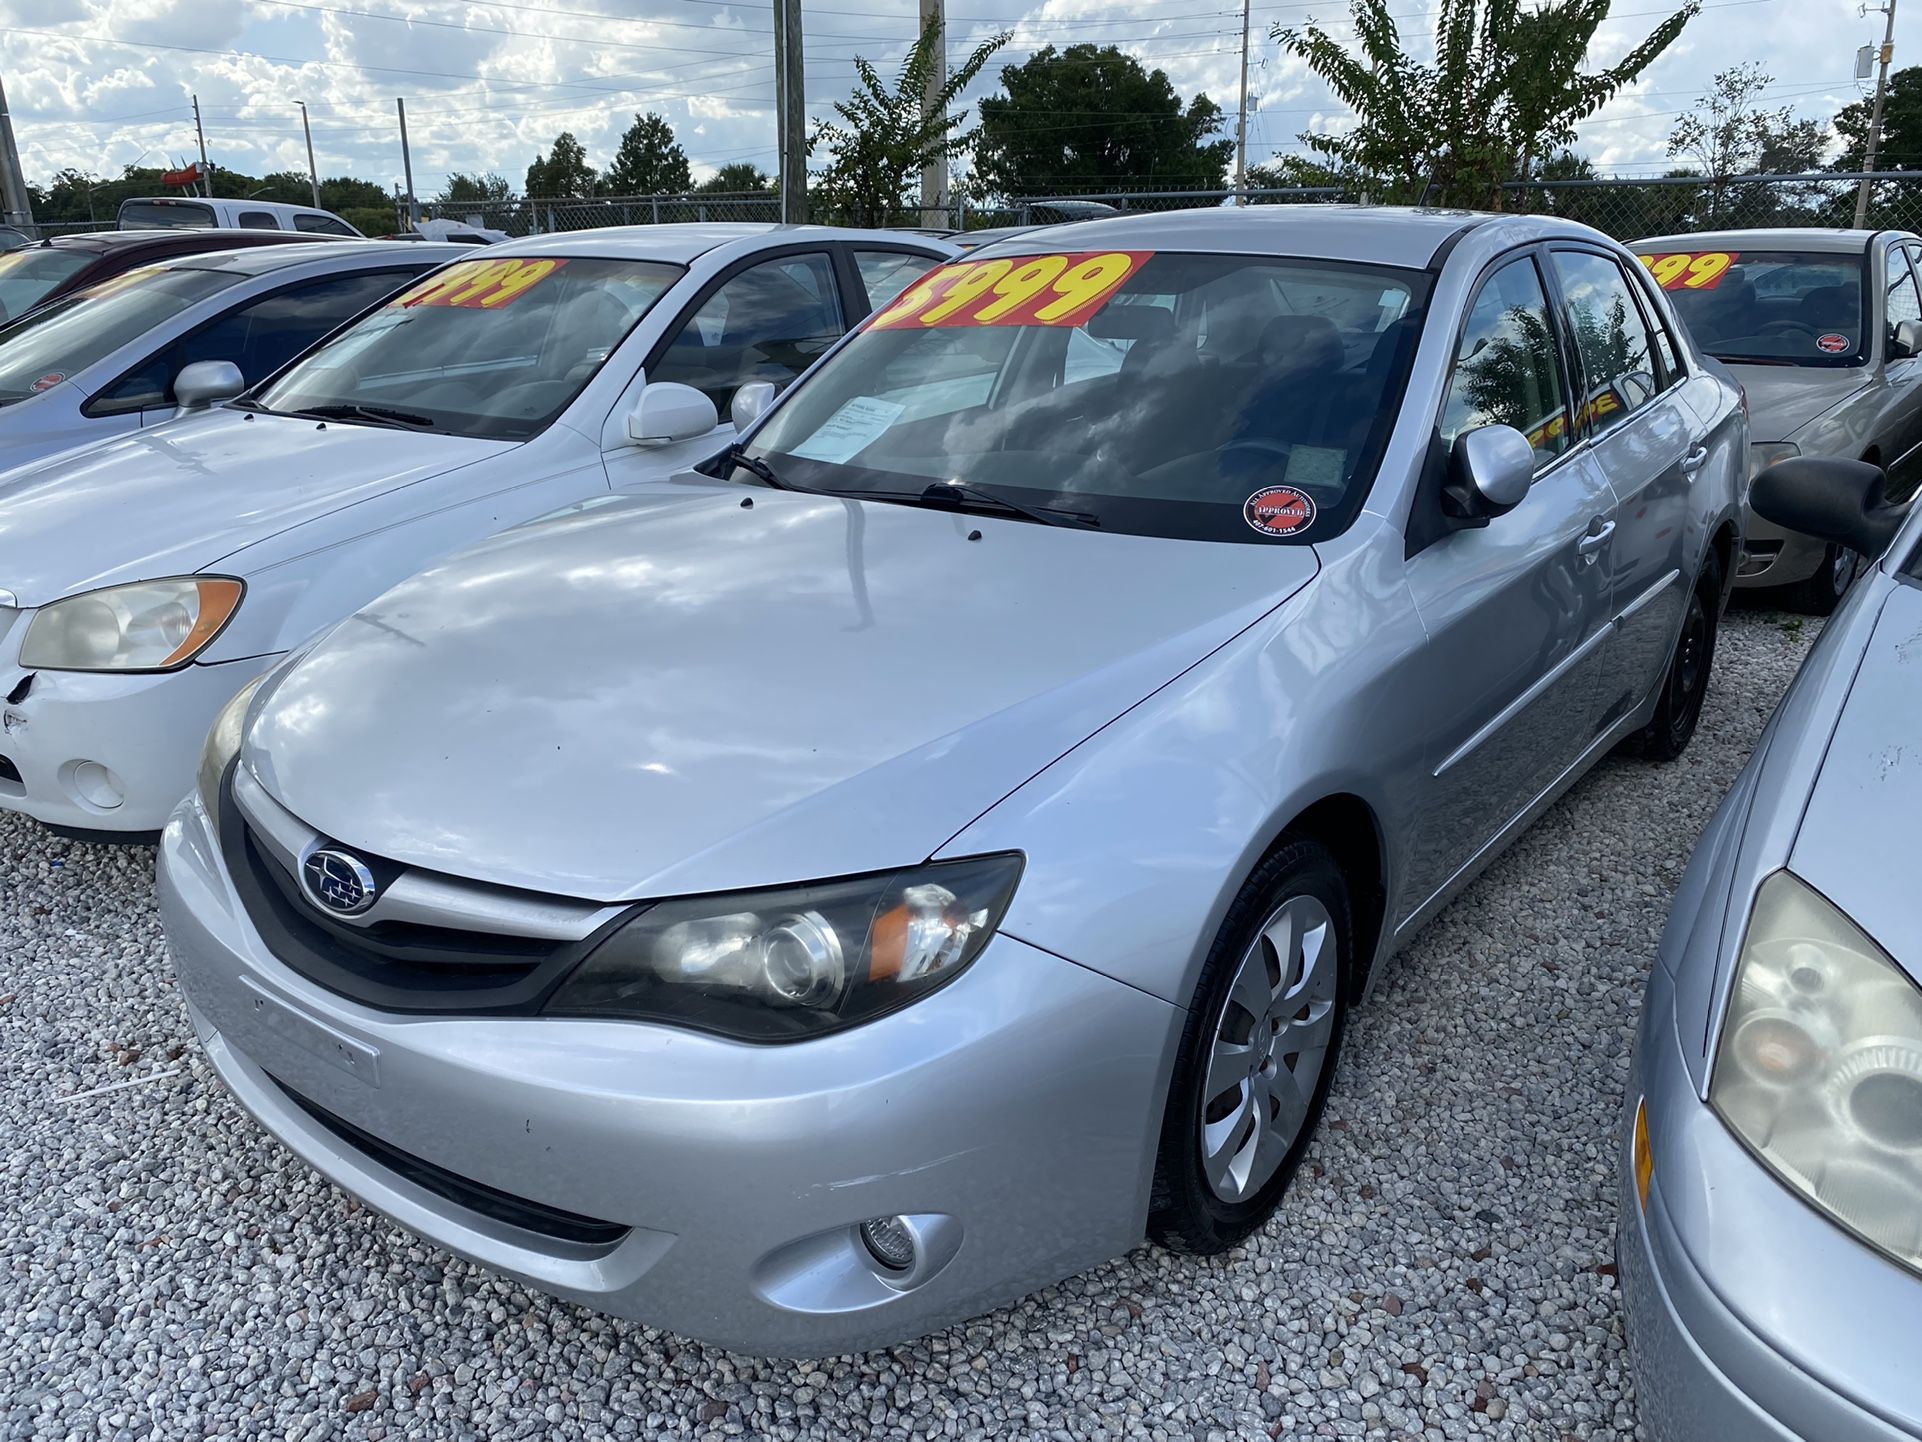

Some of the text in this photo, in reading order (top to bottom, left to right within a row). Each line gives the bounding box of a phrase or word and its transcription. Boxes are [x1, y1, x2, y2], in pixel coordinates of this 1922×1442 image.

[1638, 252, 1732, 289] 99
[873, 252, 1132, 329] 5999
[1258, 506, 1303, 516] APPROVED
